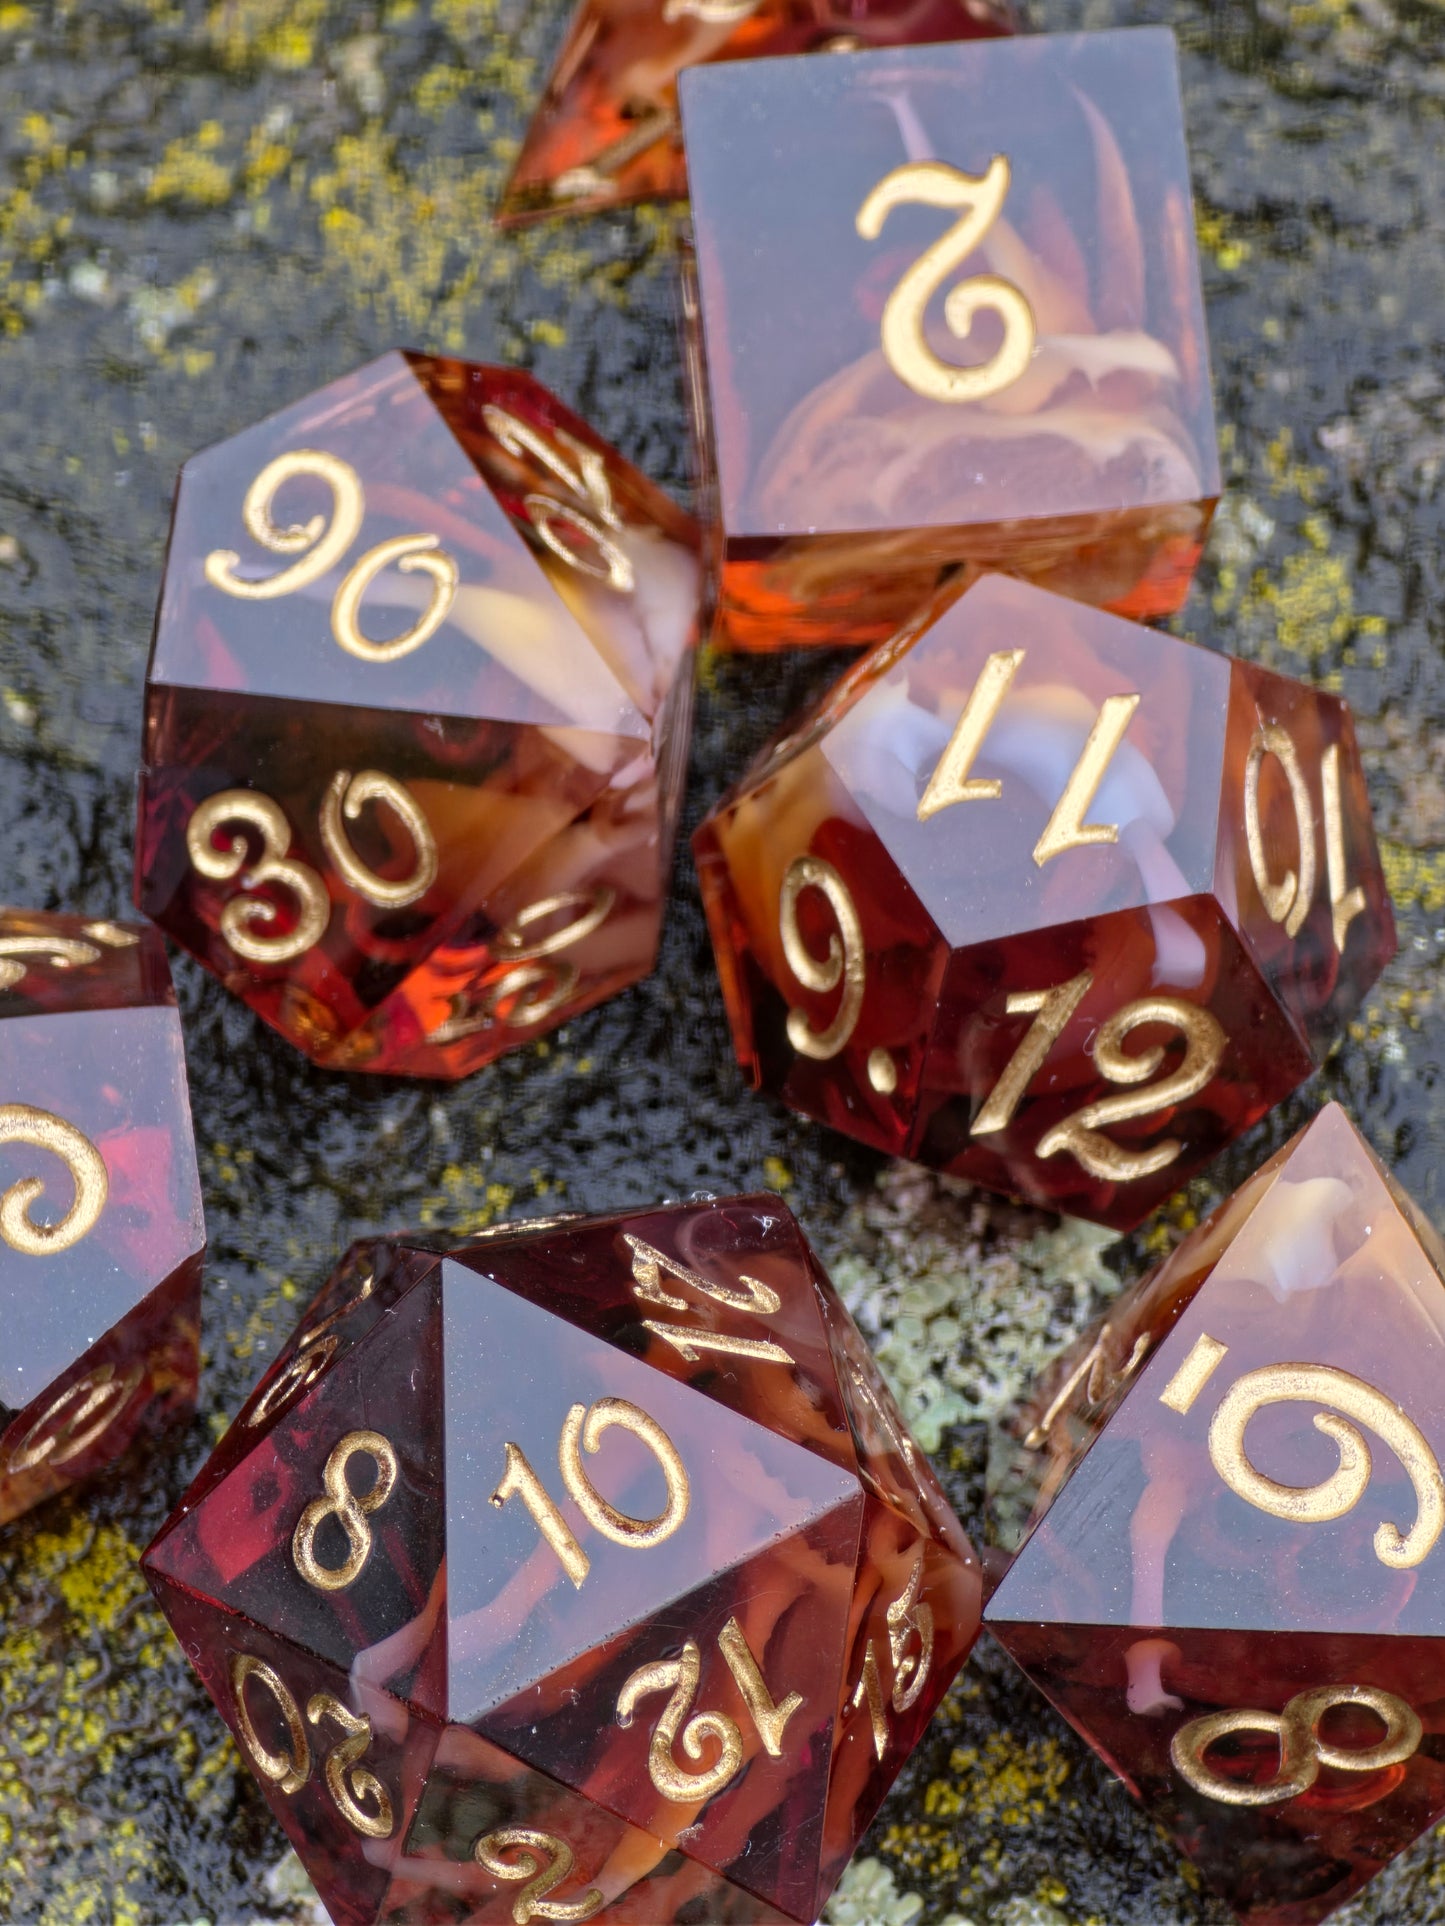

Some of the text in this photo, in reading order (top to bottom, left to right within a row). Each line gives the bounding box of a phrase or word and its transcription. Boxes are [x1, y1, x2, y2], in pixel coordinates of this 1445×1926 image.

[856, 153, 1036, 404] 2
[204, 448, 461, 663] 90
[187, 769, 437, 962] 30
[1244, 723, 1366, 953] 10
[969, 971, 1228, 1181] 12
[292, 1429, 398, 1592] 8
[488, 1397, 691, 1590] 10
[231, 1653, 395, 1838] 20
[616, 1615, 803, 1803] 12
[1171, 1684, 1423, 1806] 8
[474, 1826, 604, 1926] 2
